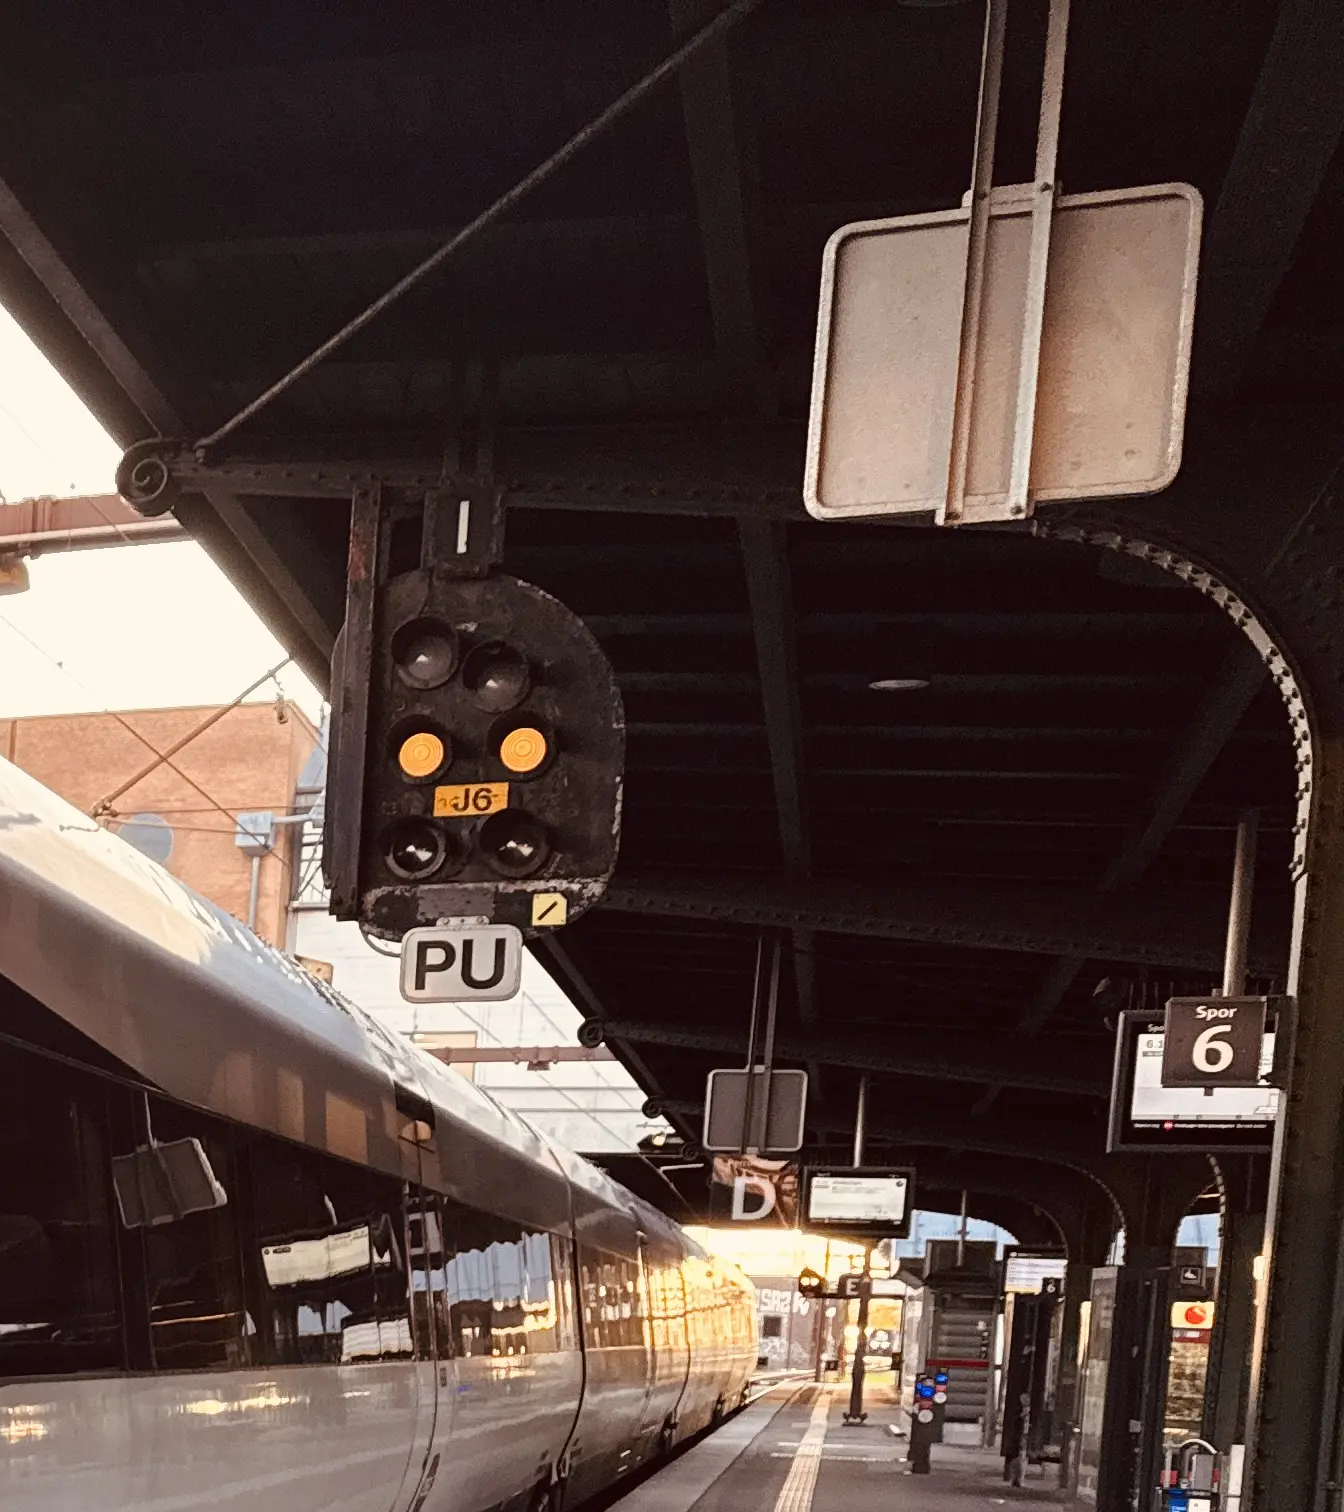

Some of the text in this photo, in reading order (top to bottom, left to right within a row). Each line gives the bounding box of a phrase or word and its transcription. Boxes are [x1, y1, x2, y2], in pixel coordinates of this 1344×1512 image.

[453, 787, 494, 813] J6
[414, 937, 507, 991] PU
[1195, 1005, 1238, 1021] Spor
[1192, 1024, 1234, 1073] 6
[732, 1176, 777, 1220] D
